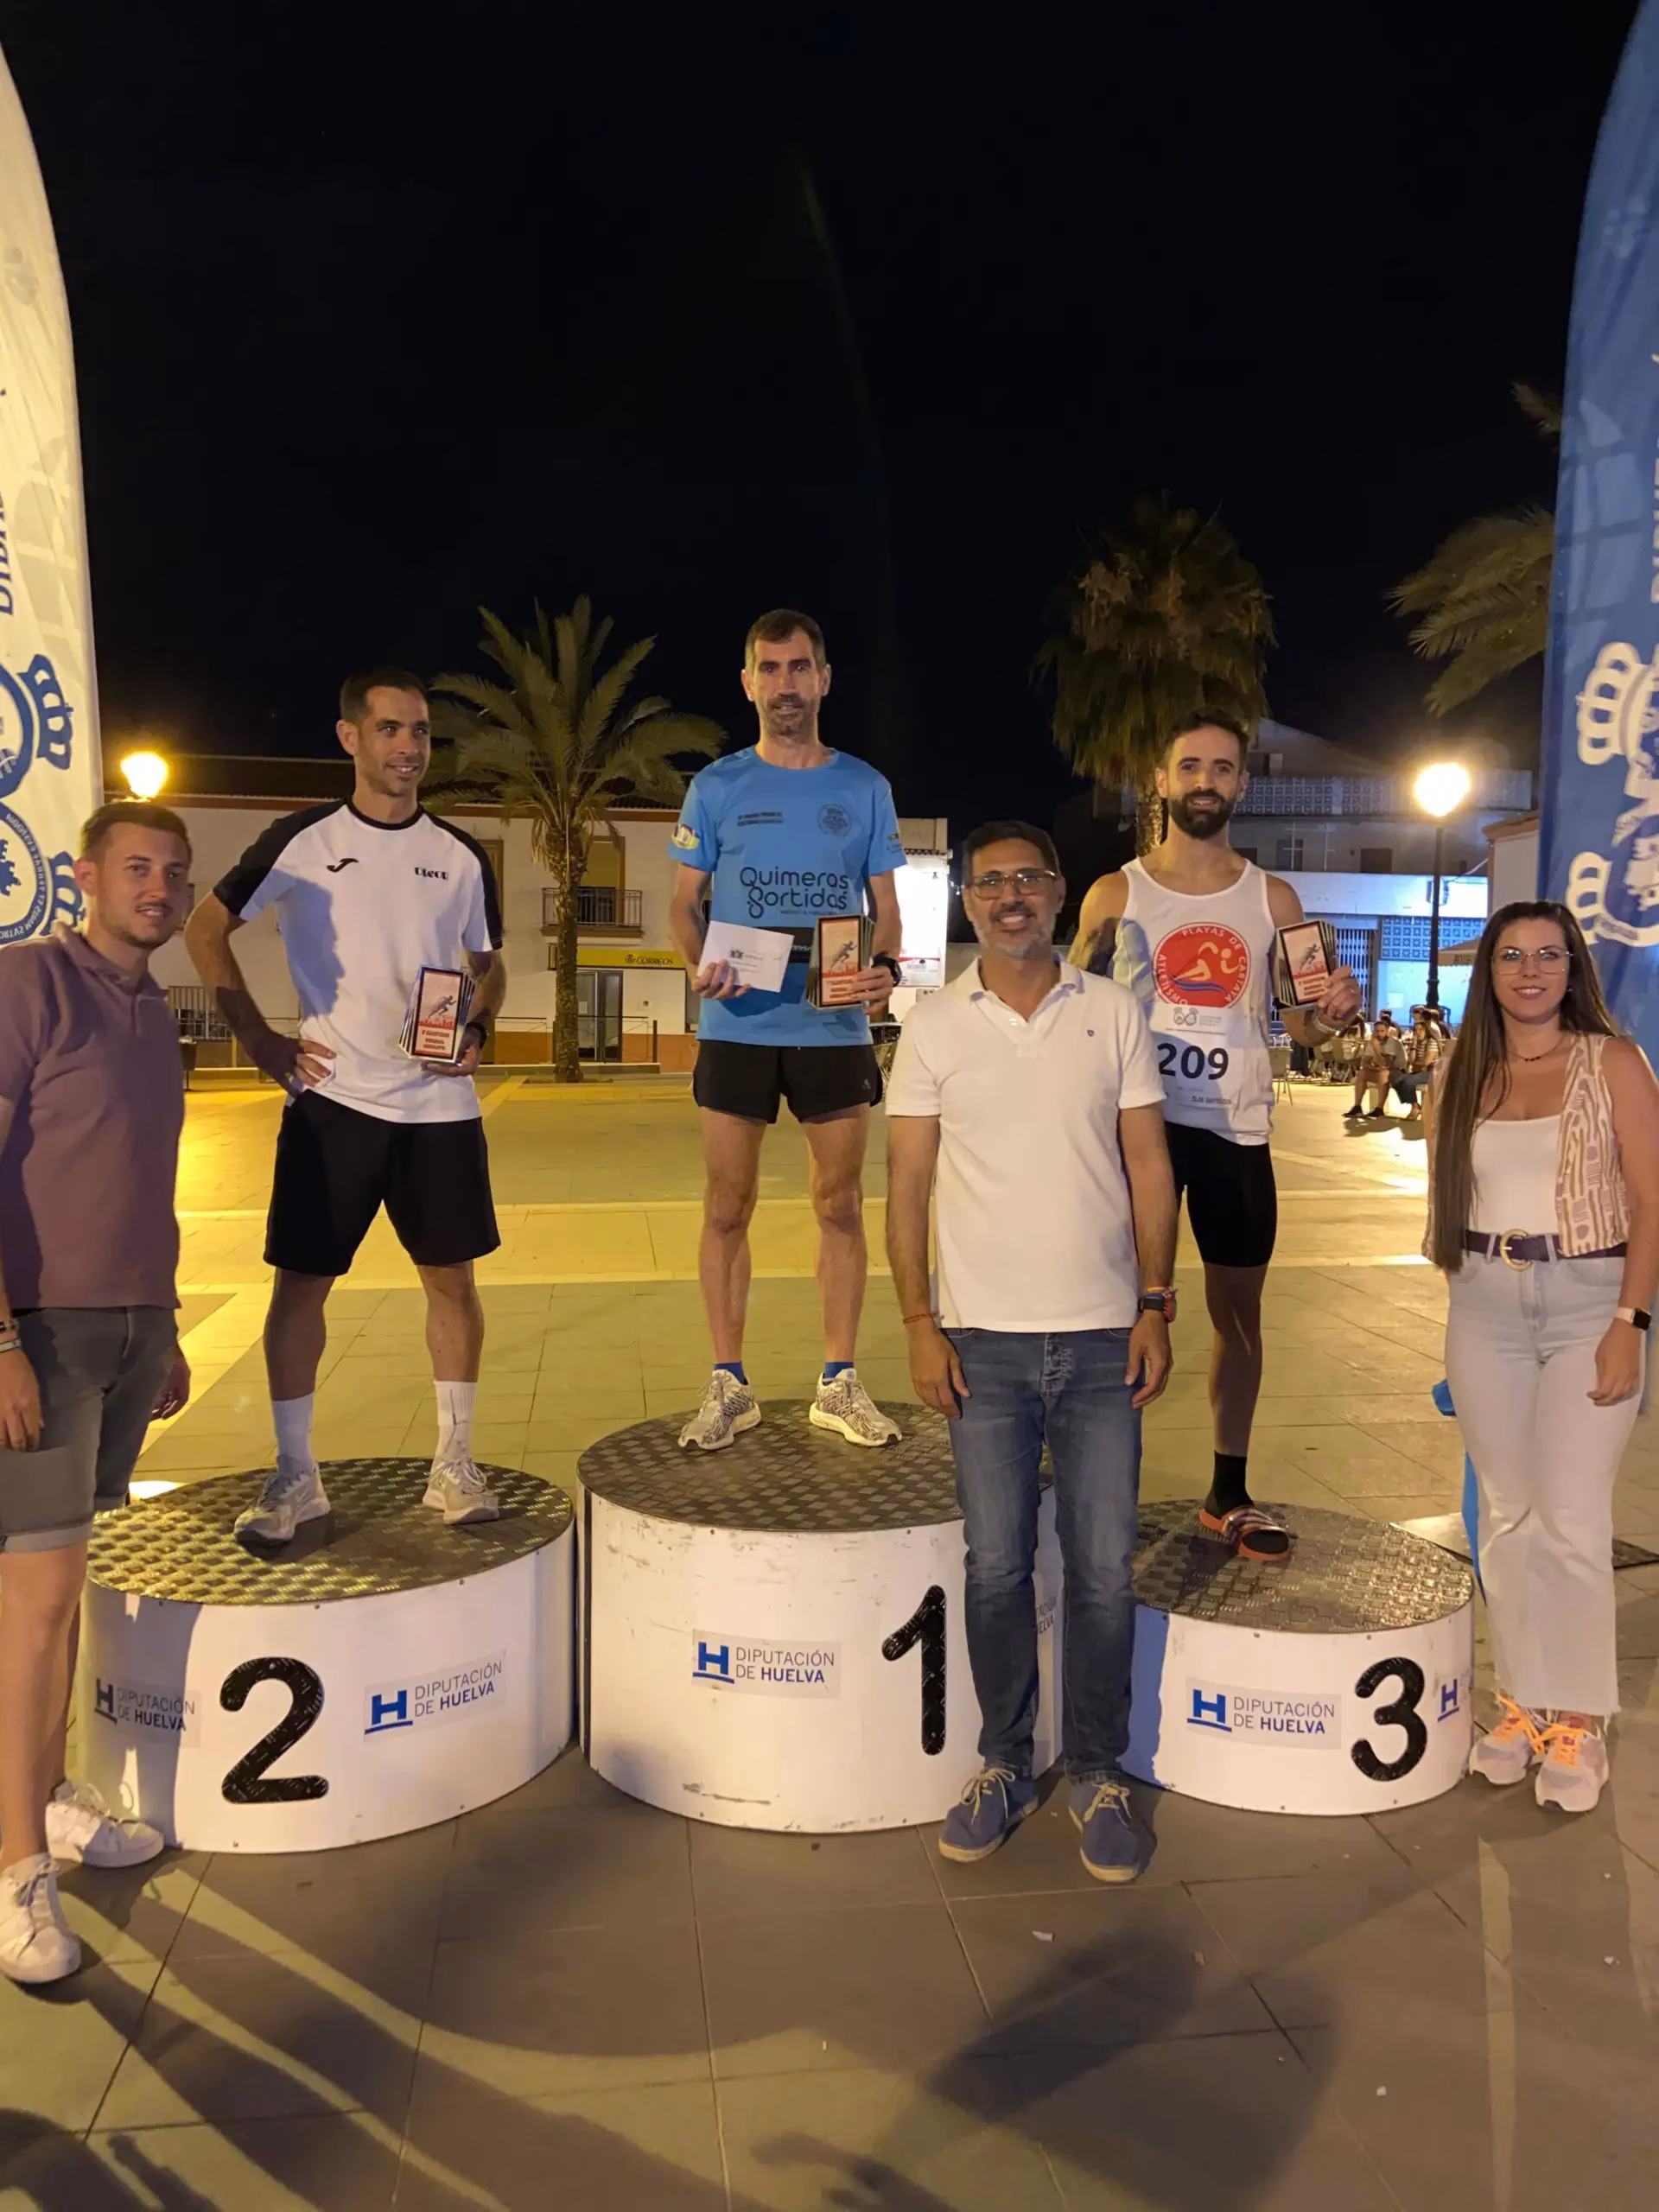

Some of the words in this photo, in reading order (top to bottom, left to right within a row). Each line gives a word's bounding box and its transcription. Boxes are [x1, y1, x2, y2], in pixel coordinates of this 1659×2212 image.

[740, 866, 849, 890] Quimeras
[747, 887, 848, 918] Sortidas
[1182, 926, 1225, 938] PLAYAS
[1229, 937, 1243, 950] DE
[1158, 954, 1189, 1006] ATLETISMO
[1225, 956, 1247, 1002] CARTAYA
[1157, 1043, 1230, 1080] 209
[736, 1647, 835, 1667] DIPUTACIÓN
[881, 1585, 946, 1756] 1
[415, 1661, 502, 1700] DIPUTACIÓN
[736, 1664, 756, 1680] DE
[761, 1667, 825, 1683] HUELVA
[118, 1688, 195, 1715] DIPUTACIÓN
[415, 1700, 435, 1718] DE
[440, 1681, 495, 1711] HUELVA
[1234, 1696, 1335, 1718] DIPUTACIÓN
[118, 1705, 130, 1721] DE
[135, 1709, 187, 1732] HUELVA
[220, 1656, 329, 1804] 2
[1234, 1713, 1255, 1729] DE
[1261, 1717, 1325, 1734] HUELVA
[1351, 1656, 1427, 1782] 3
